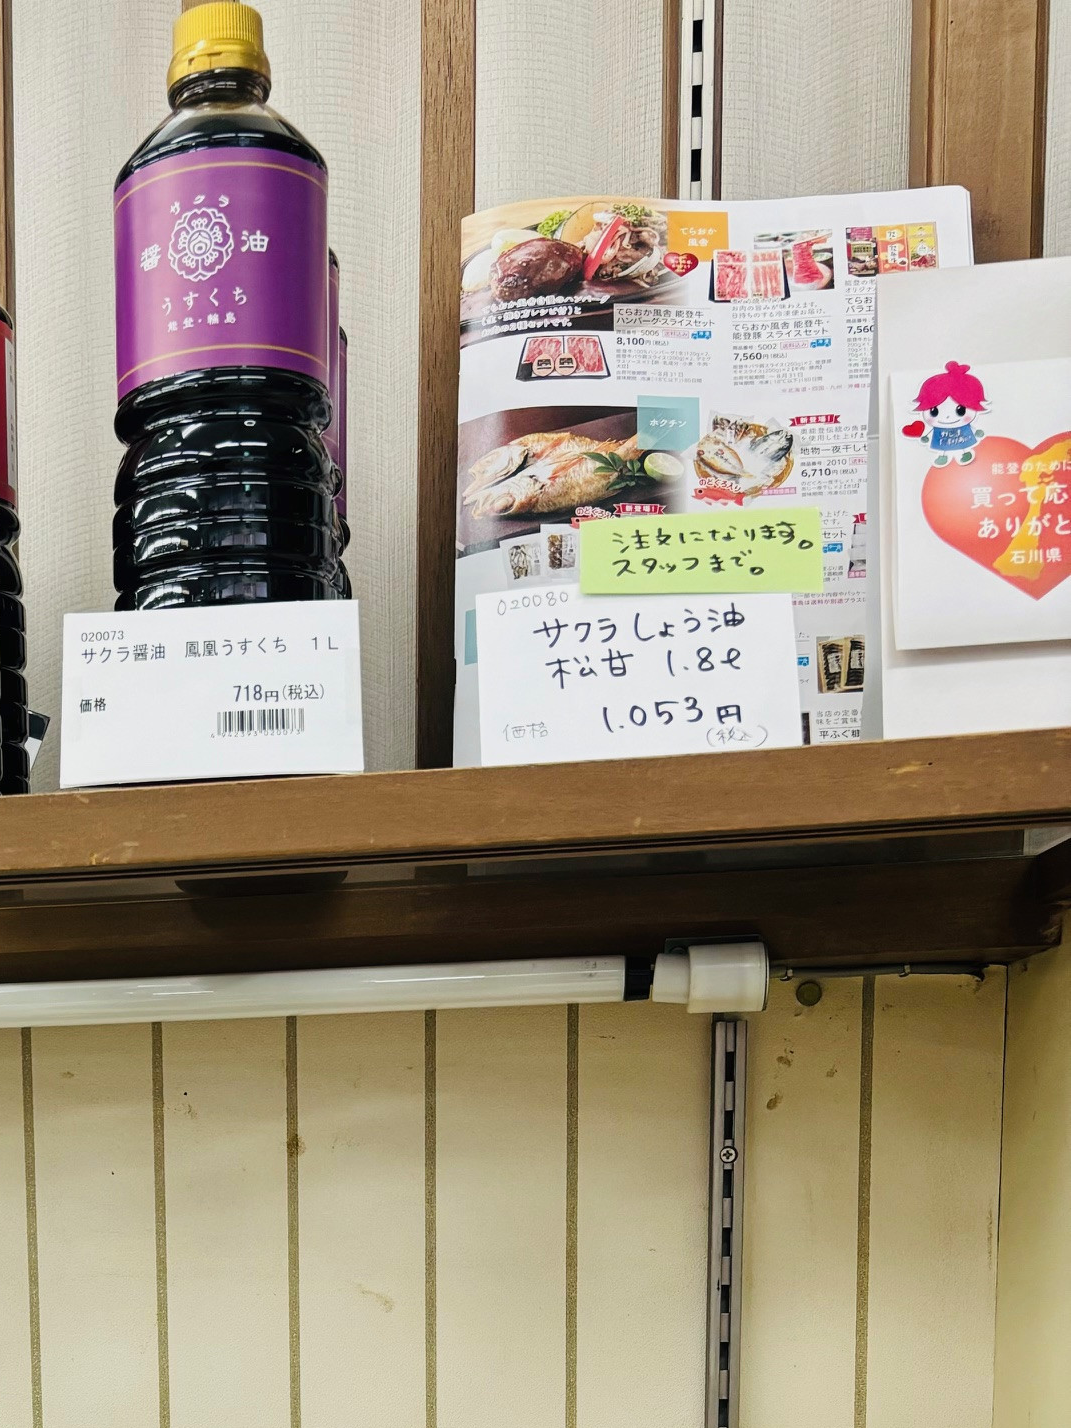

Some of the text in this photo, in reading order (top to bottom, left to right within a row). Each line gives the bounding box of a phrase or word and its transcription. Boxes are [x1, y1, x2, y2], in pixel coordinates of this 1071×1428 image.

[680, 227, 717, 236] てらおか
[162, 286, 247, 315] うすくち
[167, 312, 236, 332] 能登・輪島
[617, 308, 671, 317] てらおか風舎
[732, 321, 790, 331] てらおか風舎
[766, 328, 829, 339] スライスセット
[649, 419, 687, 428] ホクチン
[801, 468, 858, 477] 6,710円(税込)
[991, 460, 1071, 476] 能登のために
[971, 482, 1069, 509] 買って応
[822, 530, 847, 539] セット
[977, 513, 1071, 539] ありがと
[612, 521, 813, 553] 注文になります。
[612, 550, 764, 577] スタッフまで。
[1010, 547, 1062, 564] 石川県
[497, 592, 569, 616] 020080
[533, 603, 745, 648] サクラしょう油
[81, 630, 124, 642] 020073
[81, 643, 166, 664] サクラ醤油
[185, 638, 287, 658] 鳳凰うすくち
[545, 648, 634, 689] 松甘
[233, 683, 325, 703] 718円(税込)
[80, 698, 107, 714] 価格
[502, 722, 549, 742] 価格
